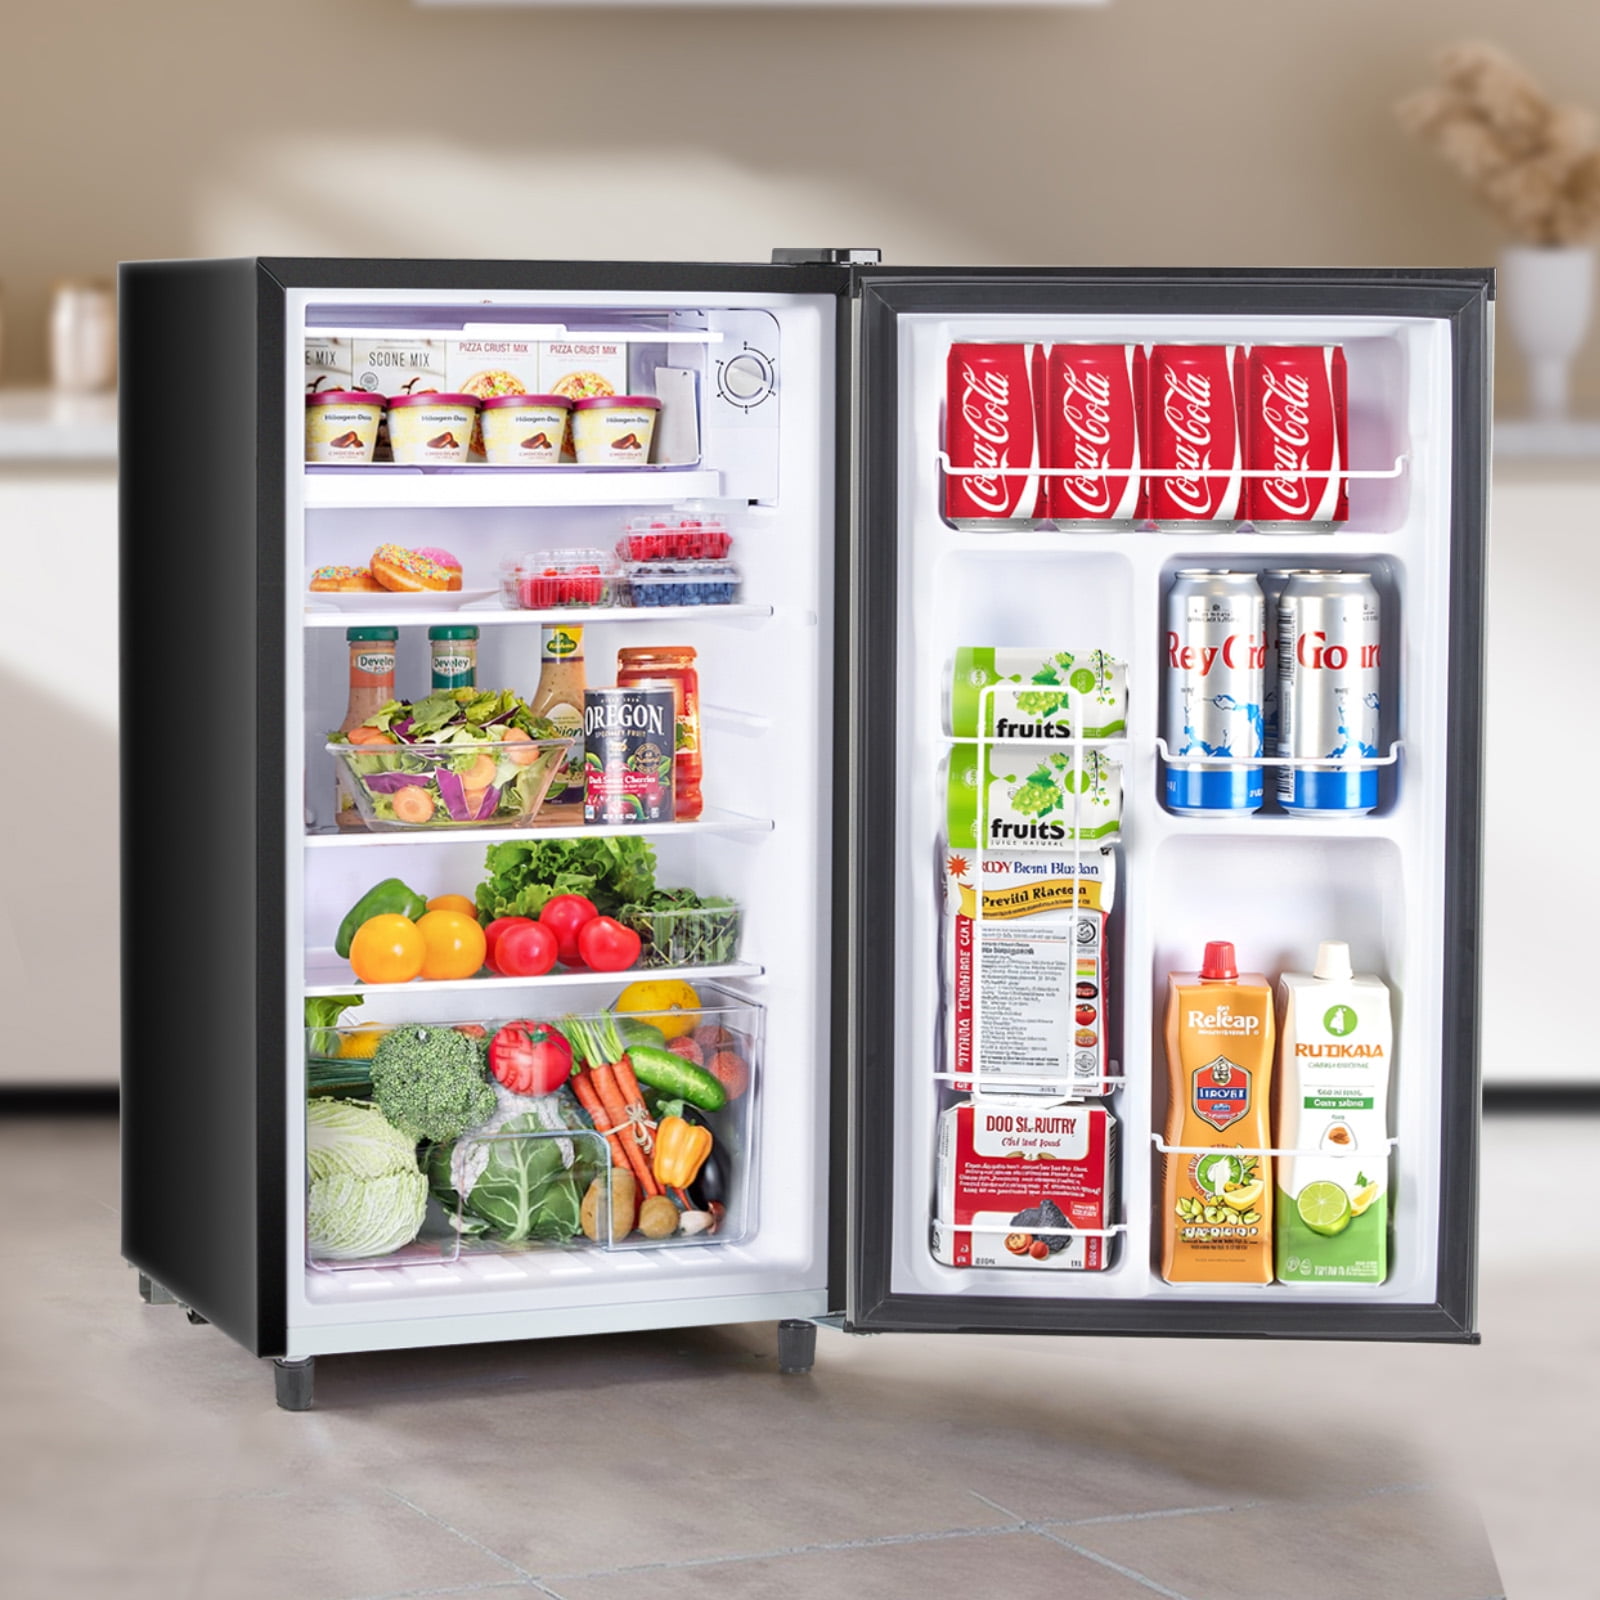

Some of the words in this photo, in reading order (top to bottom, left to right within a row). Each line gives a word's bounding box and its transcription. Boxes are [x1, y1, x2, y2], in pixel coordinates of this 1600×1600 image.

[459, 342, 482, 353] PIZZA
[484, 343, 511, 353] CRUST
[513, 344, 529, 353] MIX
[550, 345, 573, 354] PIZZA
[575, 345, 600, 355] CRUST
[602, 346, 617, 354] MIX
[316, 351, 337, 366] MIX
[368, 352, 405, 367] SCONE
[410, 353, 430, 367] MIX
[585, 704, 665, 736] OREGON
